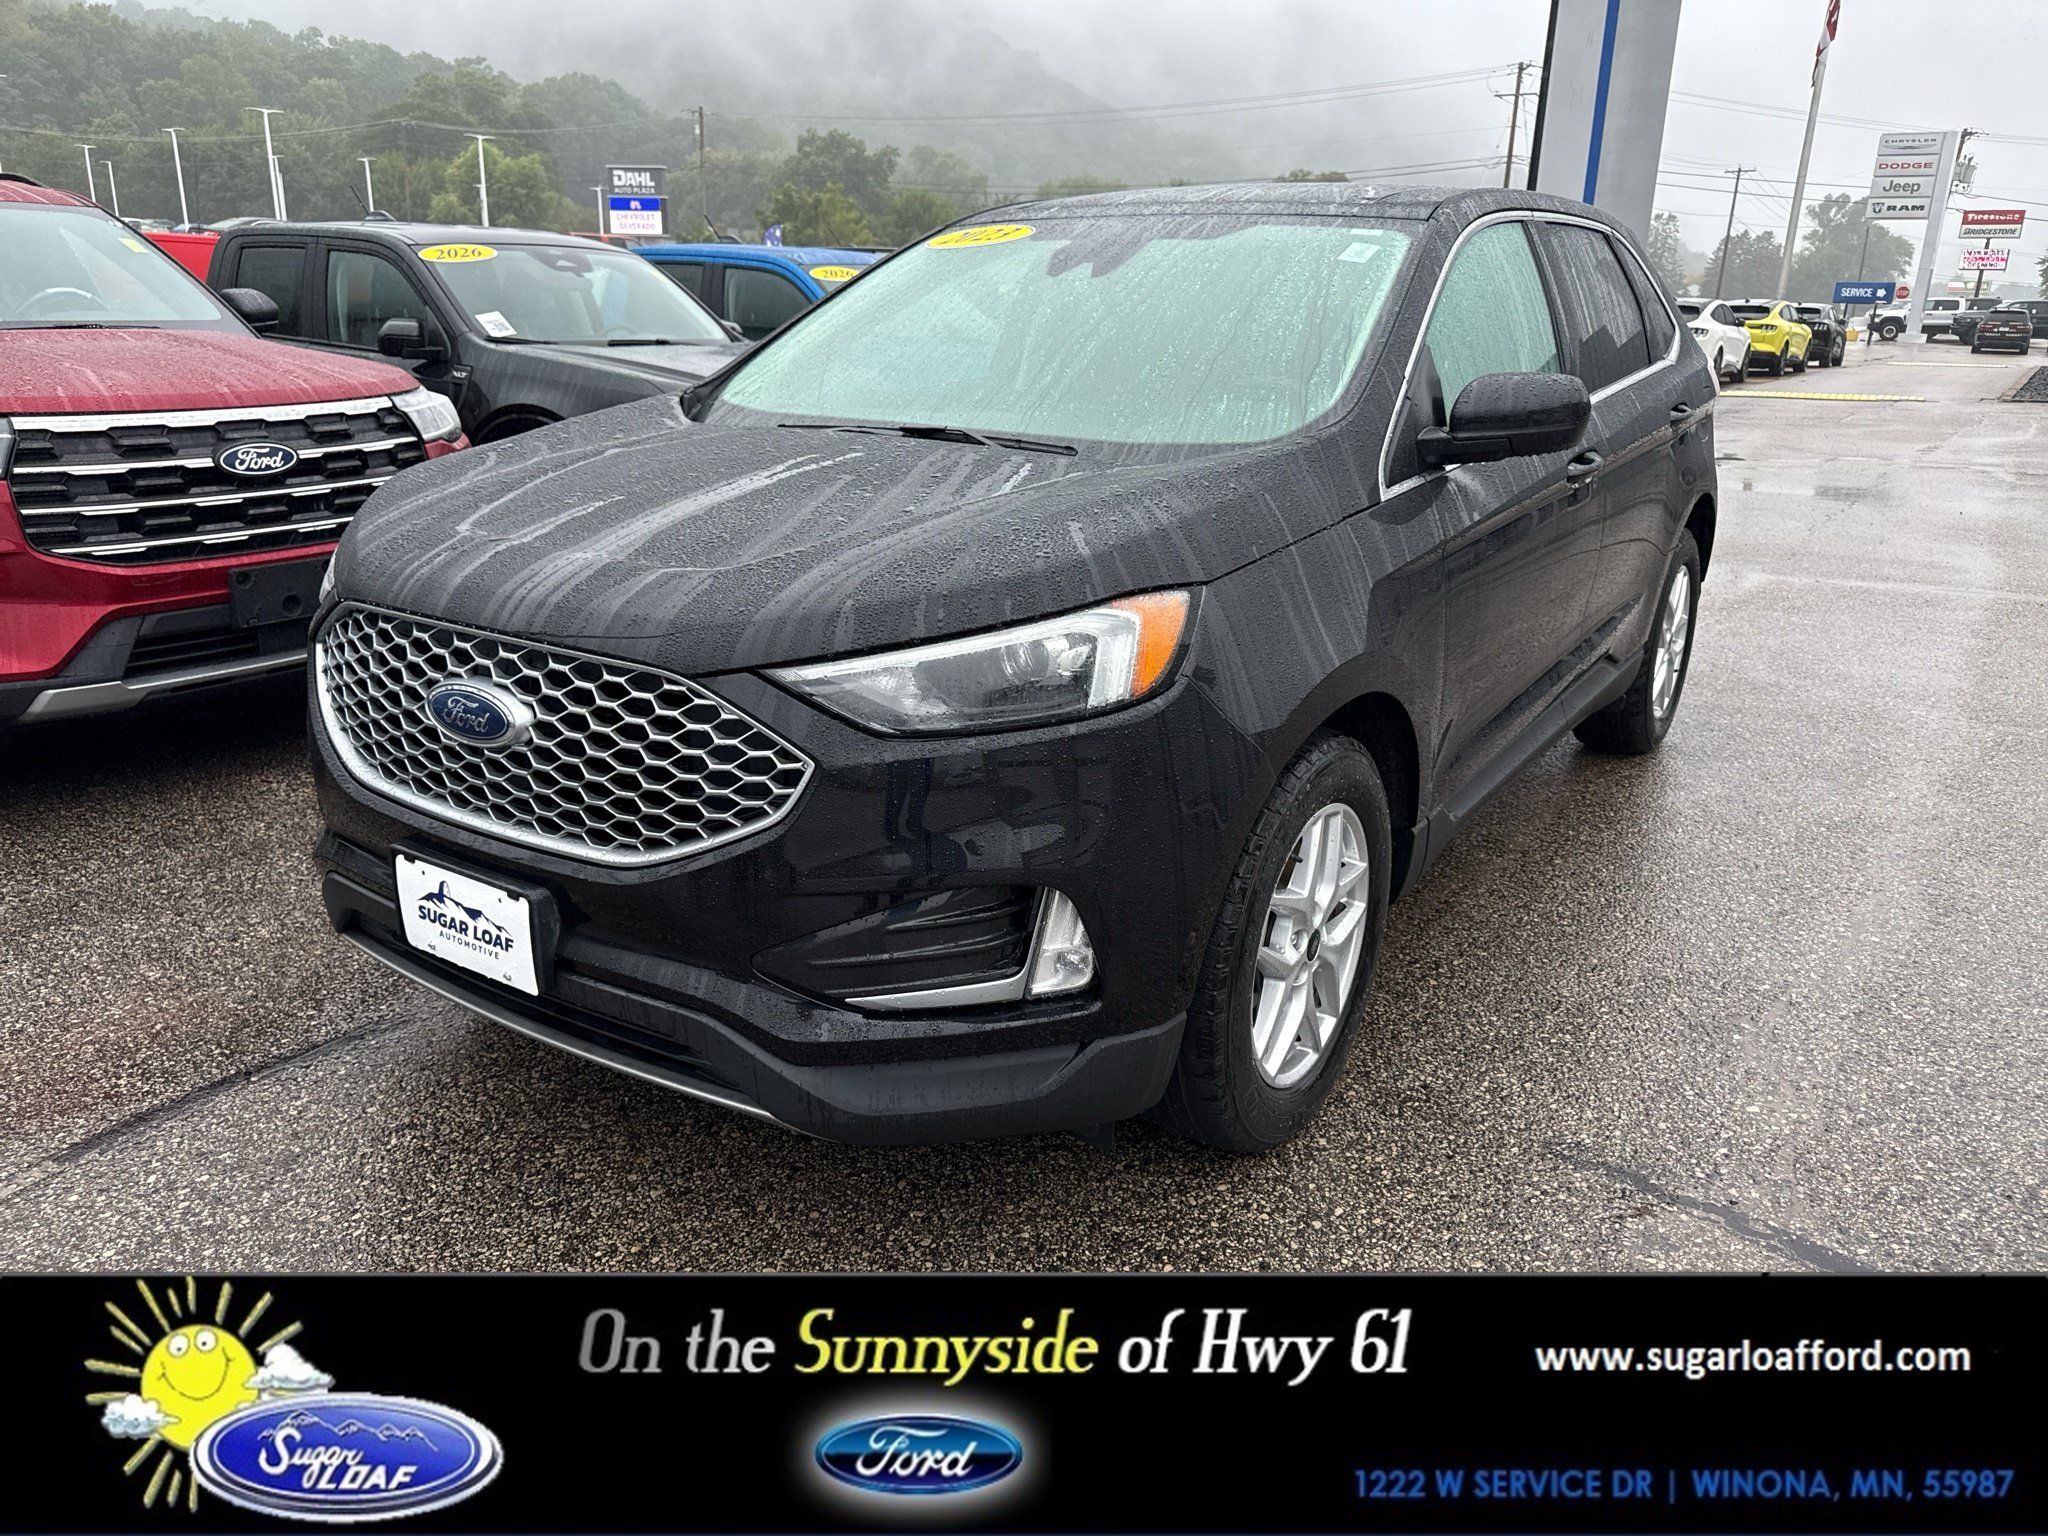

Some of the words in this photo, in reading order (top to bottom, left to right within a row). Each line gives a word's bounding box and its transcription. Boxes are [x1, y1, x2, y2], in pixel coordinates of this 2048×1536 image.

[612, 169, 656, 187] DAHL
[1883, 180, 1921, 194] Jeep
[1967, 213, 2020, 221] Firestone
[434, 247, 483, 260] 2026
[1840, 287, 1874, 298] SERVICE
[234, 447, 285, 471] Ford
[442, 695, 490, 733] Ford
[418, 904, 469, 938] SUGAR
[473, 924, 514, 953] LOAF
[439, 929, 500, 960] AUTOMOTIVE
